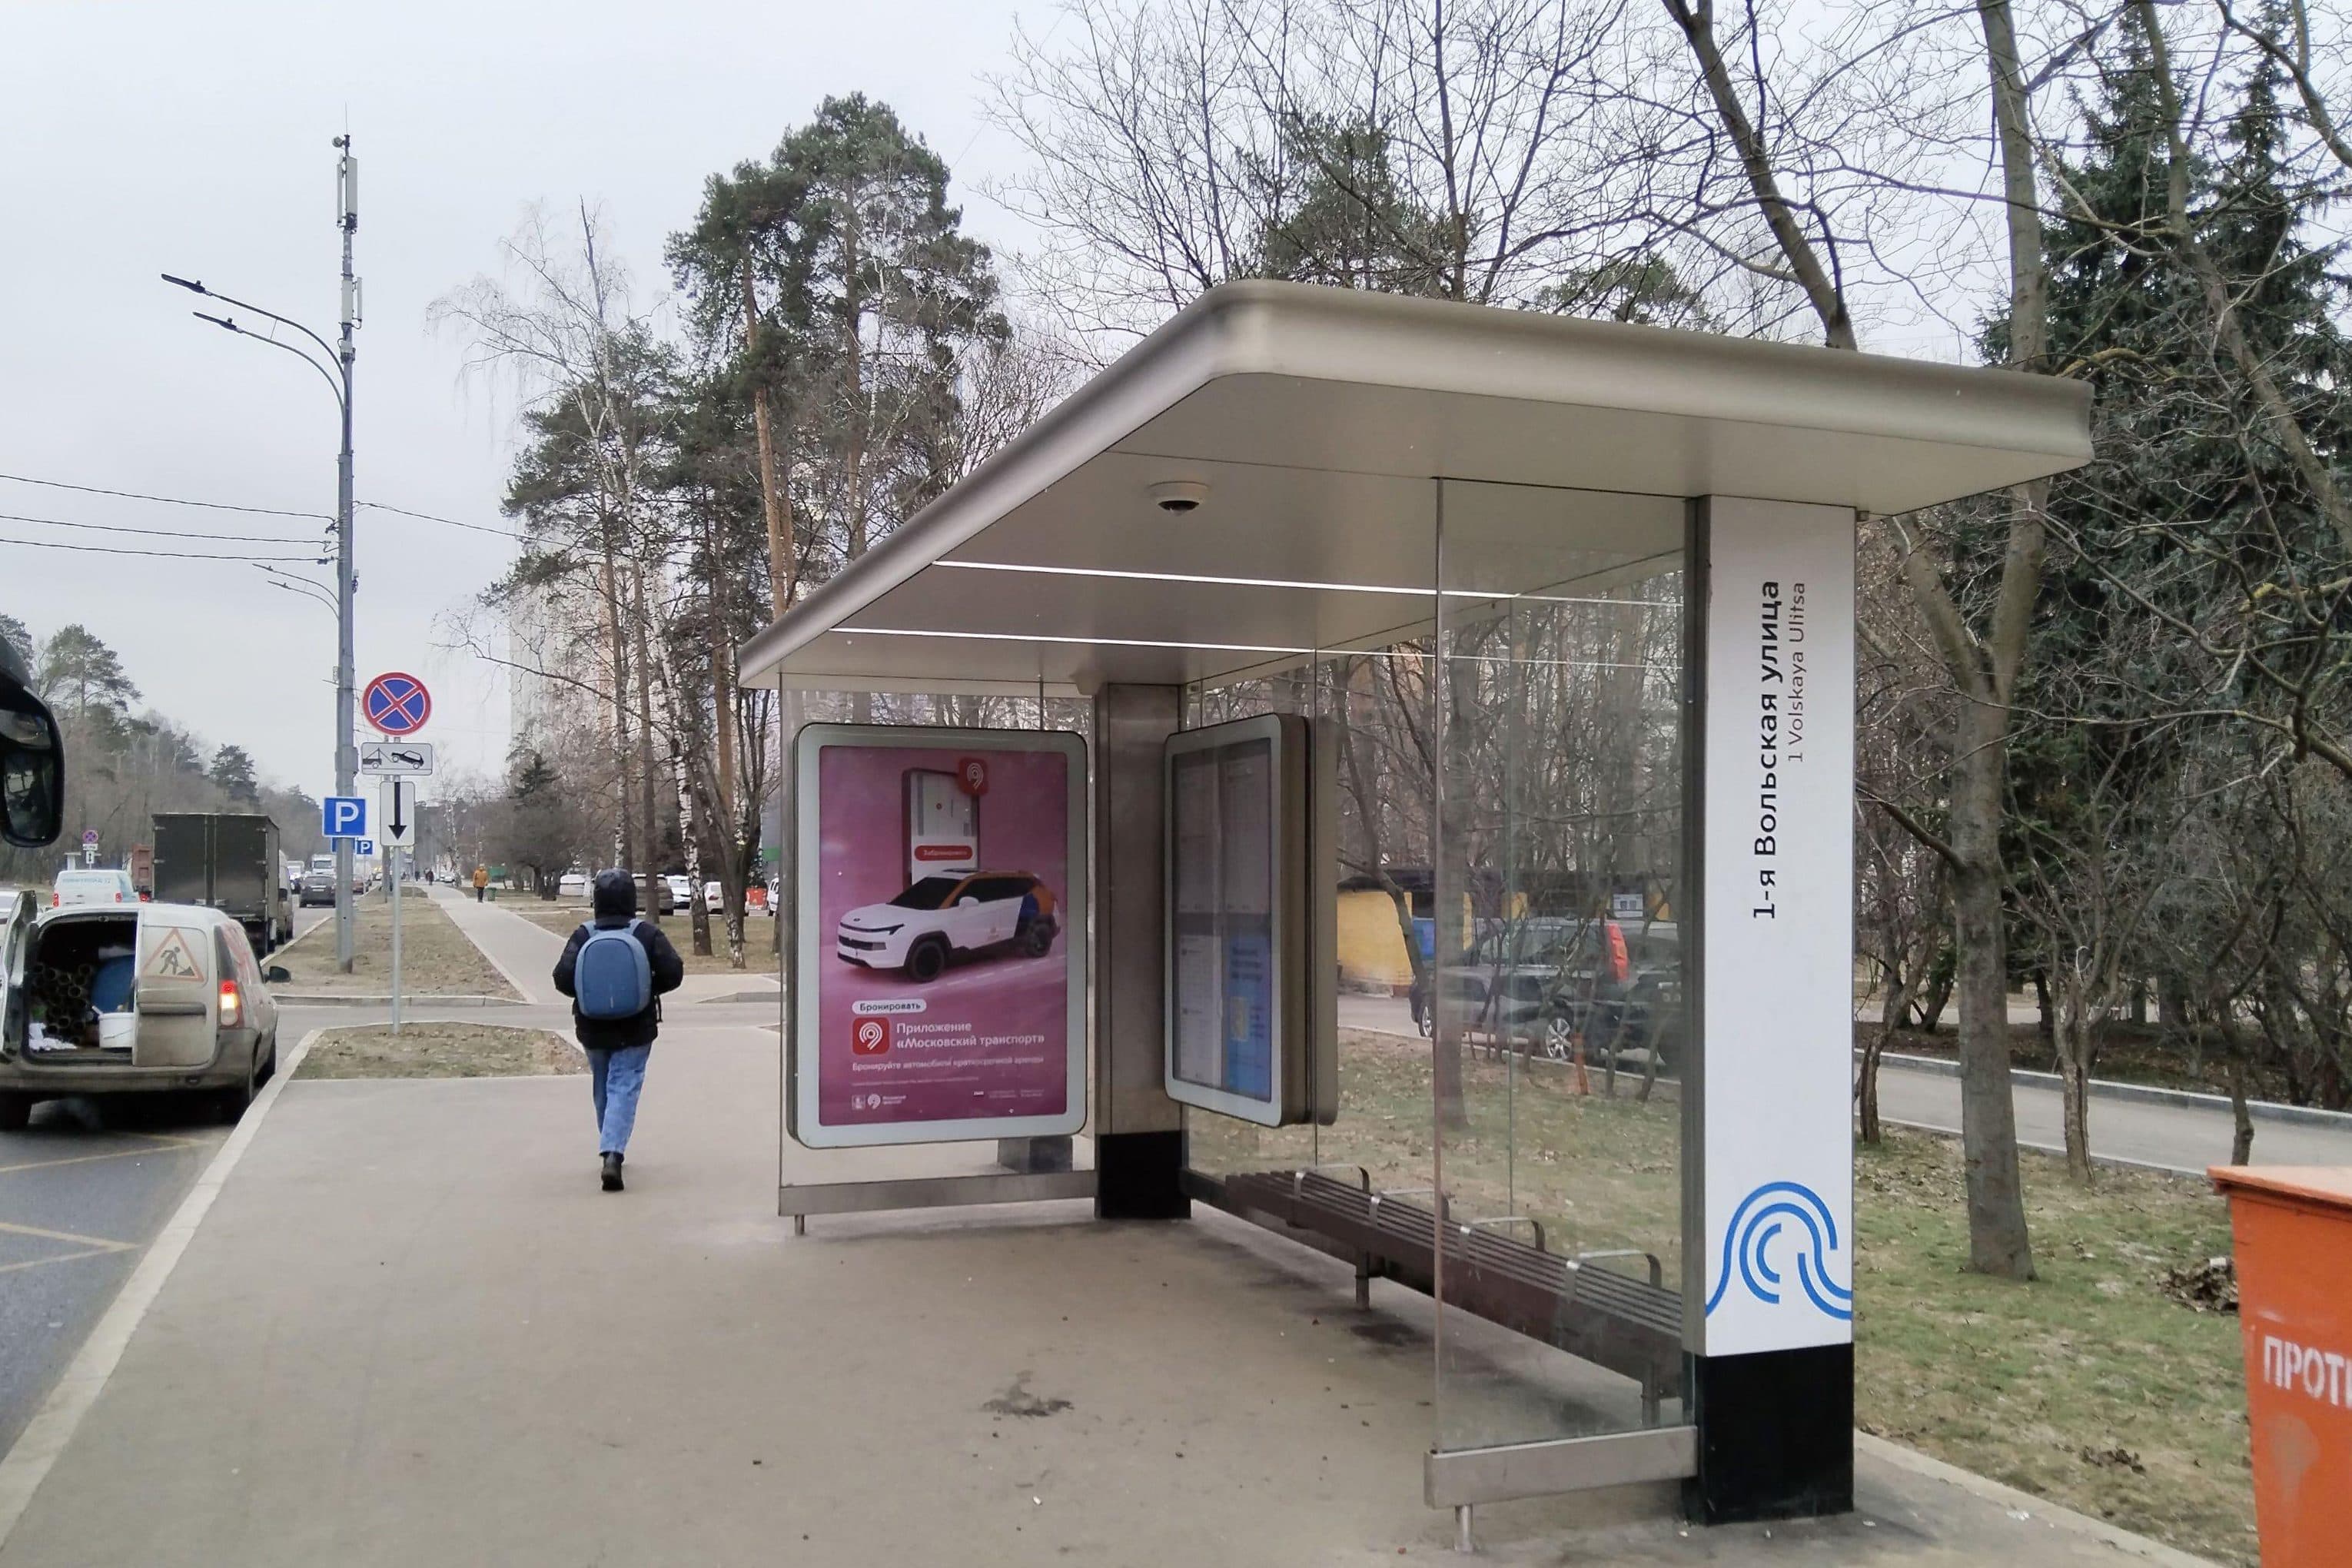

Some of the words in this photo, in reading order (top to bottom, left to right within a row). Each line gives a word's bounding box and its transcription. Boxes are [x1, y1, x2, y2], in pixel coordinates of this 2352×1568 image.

[1761, 581, 1782, 683] улица
[1788, 582, 1805, 643] Ulitsa
[1787, 651, 1806, 746] Volskaya
[1753, 693, 1778, 855] Вольская
[1788, 752, 1803, 762] 1
[335, 801, 359, 832] P
[1753, 869, 1776, 919] 1-я
[859, 1002, 921, 1012] Бронировать
[896, 1022, 972, 1035] Приложение
[896, 1035, 978, 1049] «Московский
[980, 1034, 1045, 1048] транспорт»
